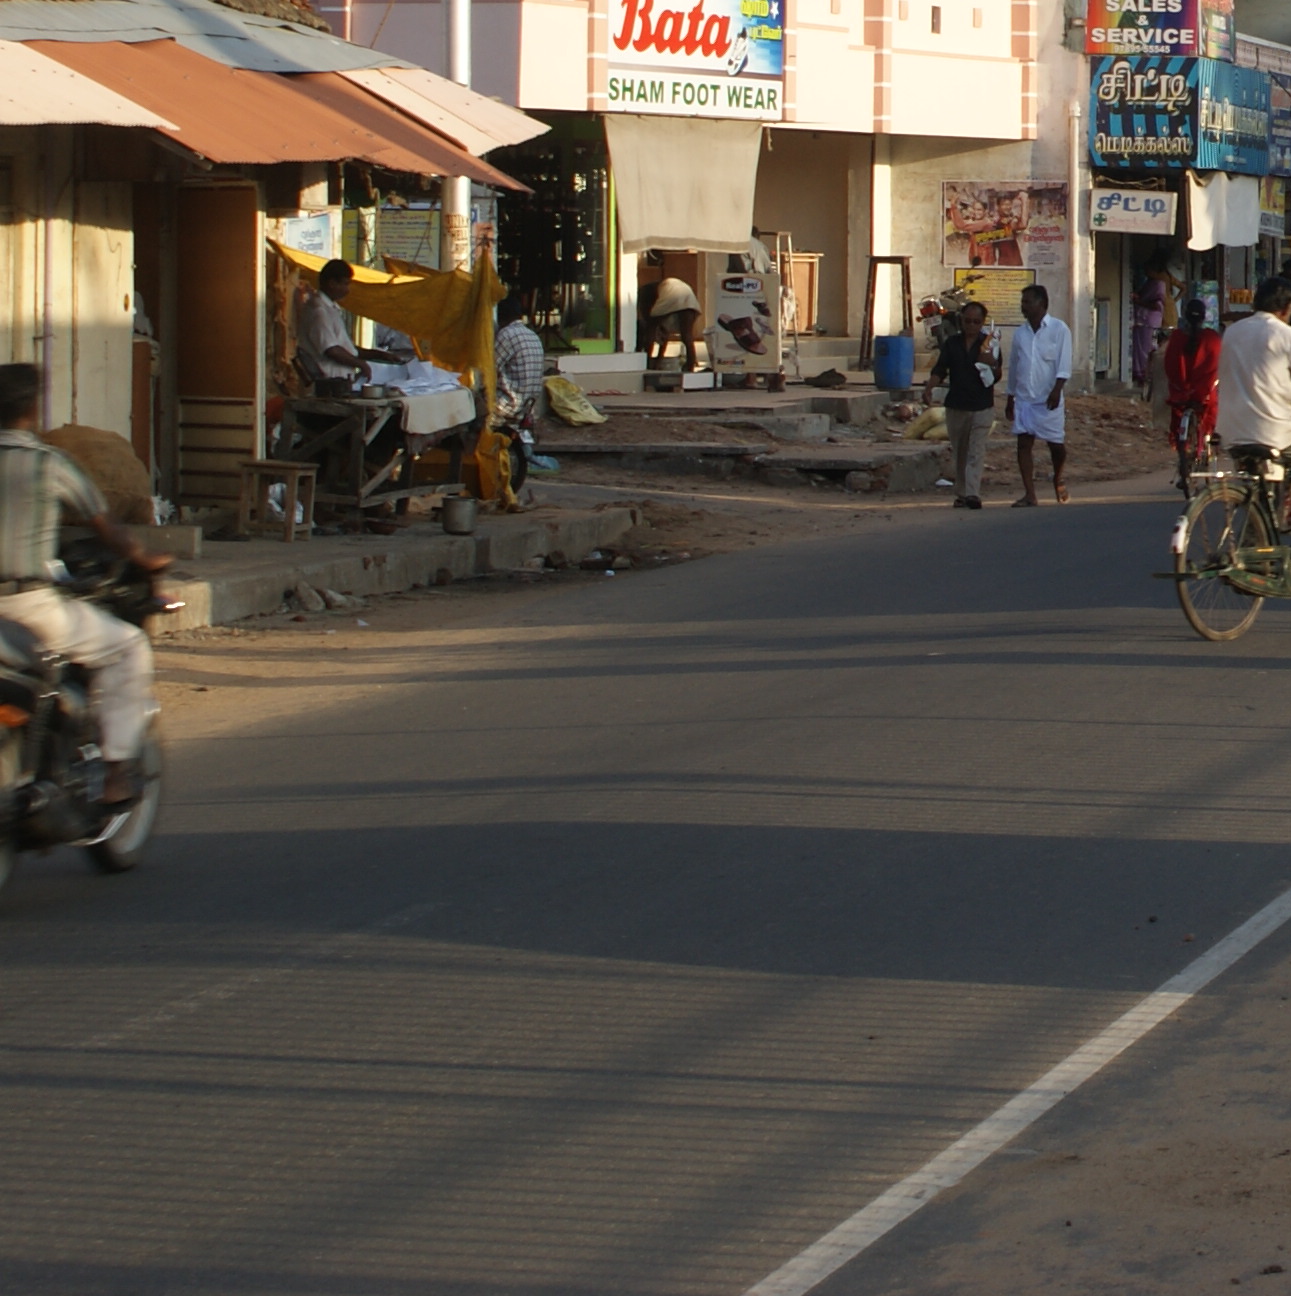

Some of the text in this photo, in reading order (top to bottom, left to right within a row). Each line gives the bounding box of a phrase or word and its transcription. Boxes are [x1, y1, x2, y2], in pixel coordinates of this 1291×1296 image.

[1090, 27, 1194, 44] SERVICE
[1136, 14, 1150, 26] &
[608, 77, 778, 110] SHAM FOOT WEAR
[1098, 61, 1190, 115] சிட்டி
[1094, 126, 1193, 159] மெடிக்கல்ஸ்
